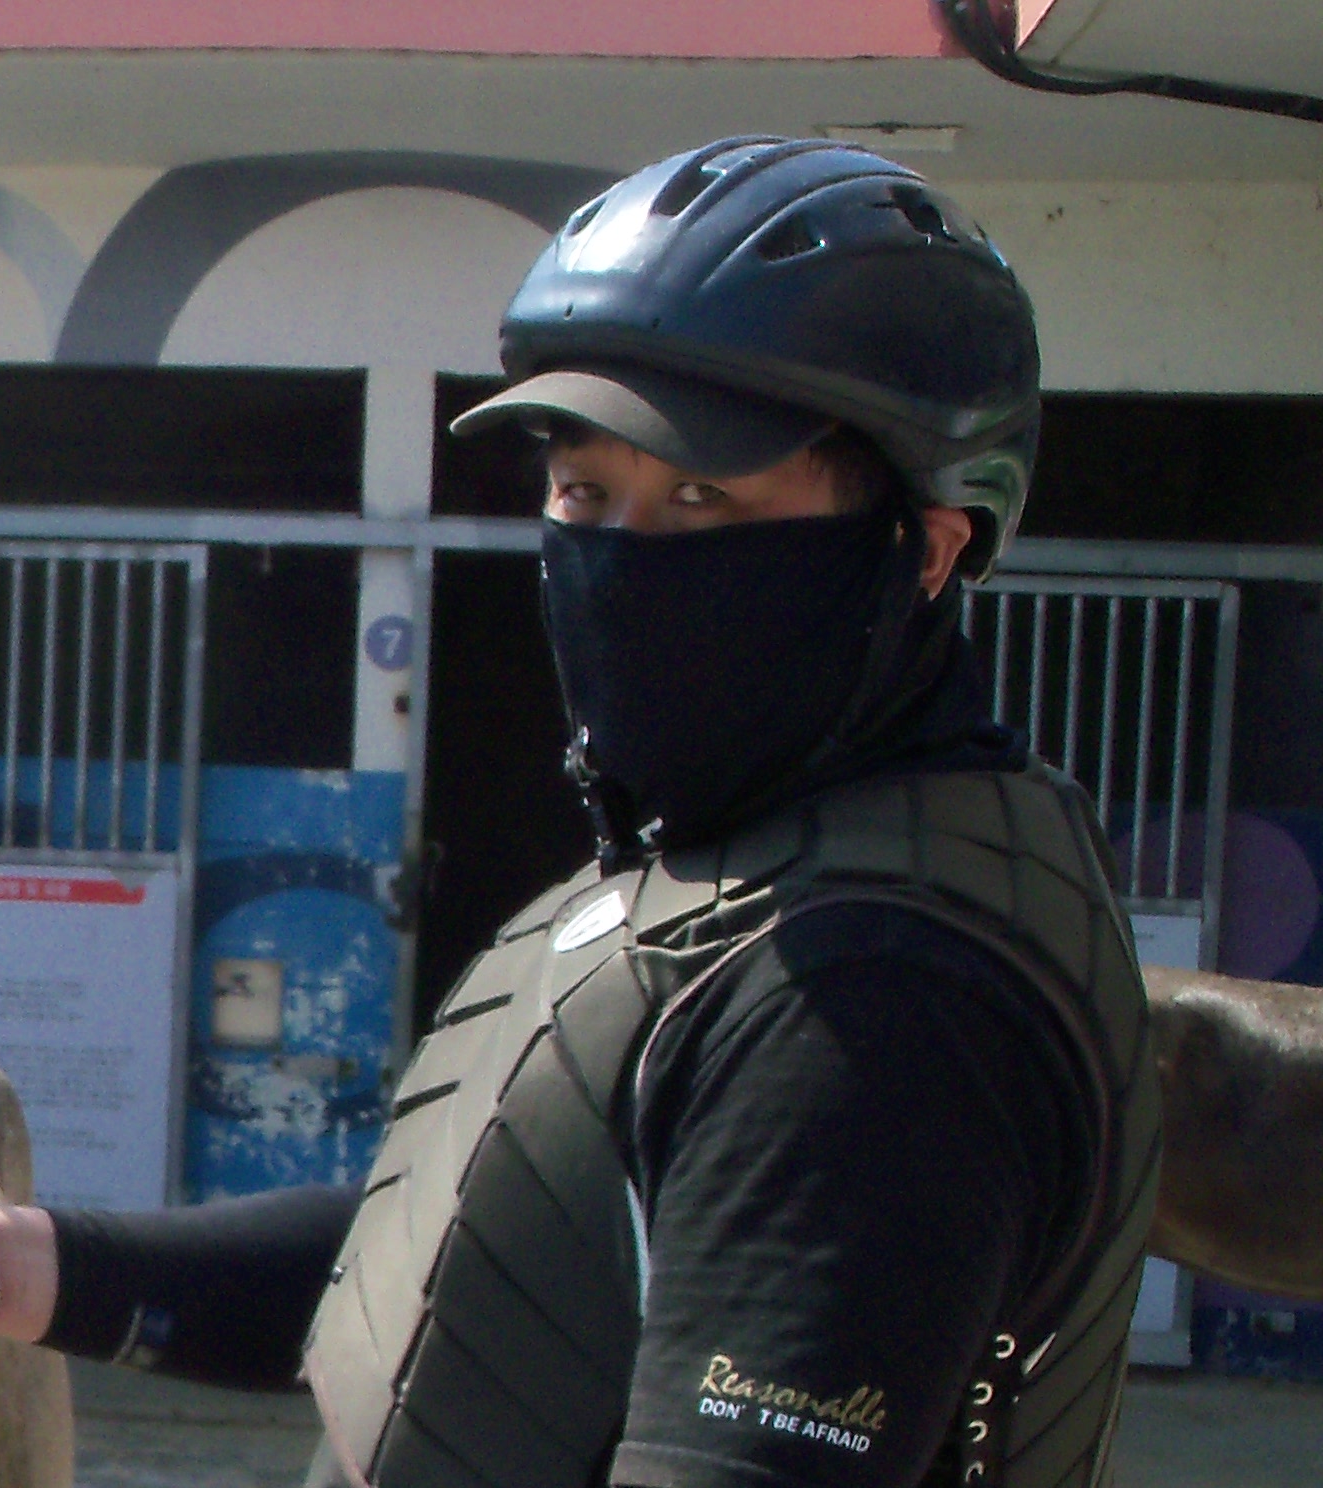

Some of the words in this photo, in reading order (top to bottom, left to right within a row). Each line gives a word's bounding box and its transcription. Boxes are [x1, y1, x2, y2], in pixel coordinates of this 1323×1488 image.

[382, 629, 403, 660] 7
[773, 1412, 801, 1433] BE
[801, 1420, 871, 1453] AFRAID
